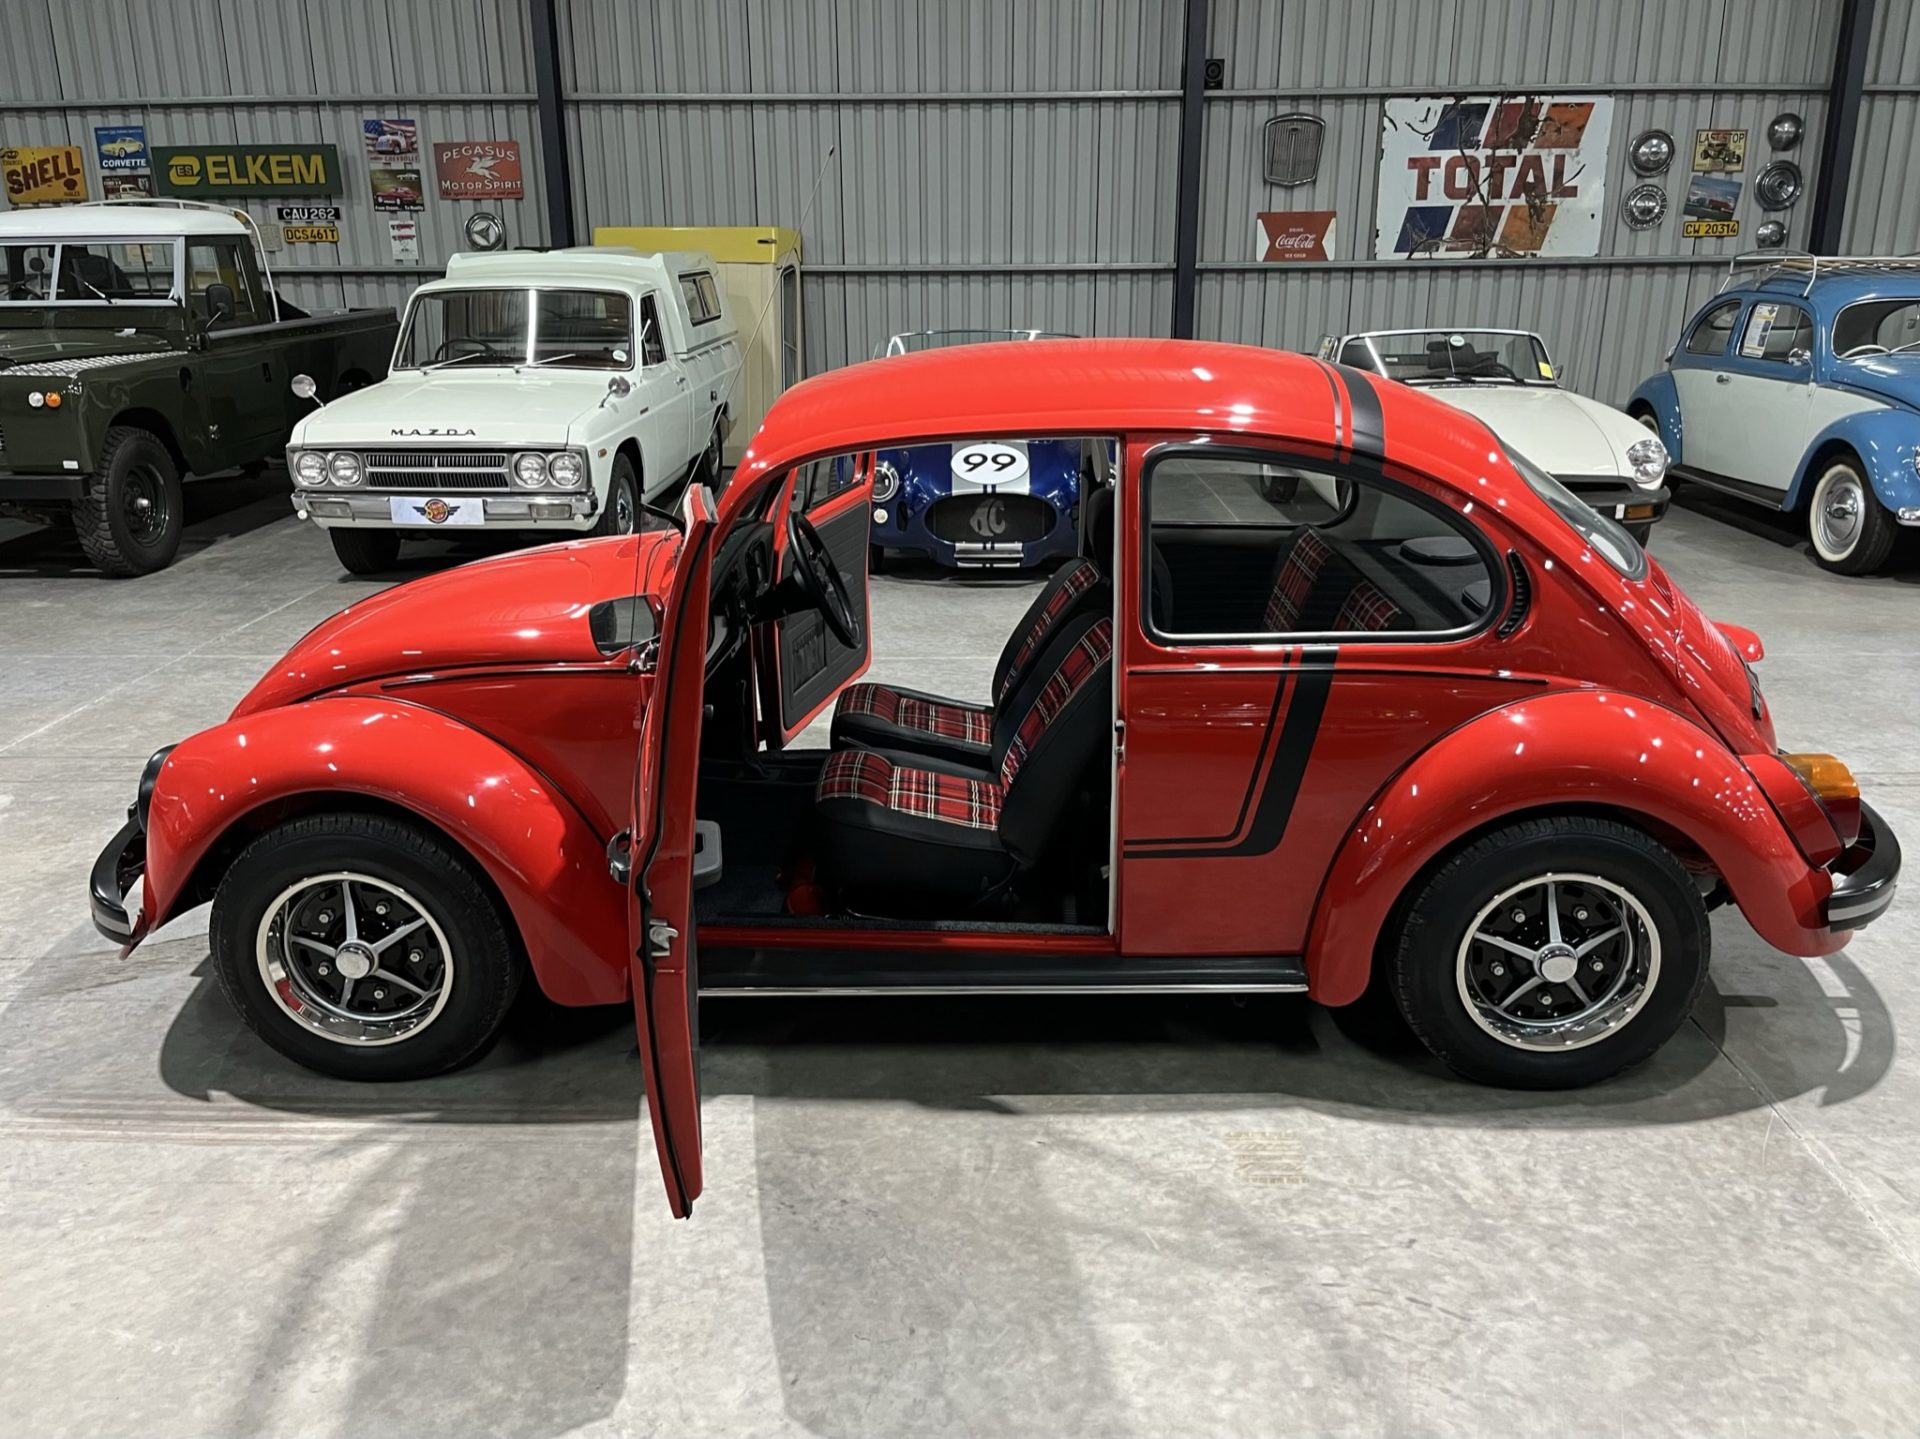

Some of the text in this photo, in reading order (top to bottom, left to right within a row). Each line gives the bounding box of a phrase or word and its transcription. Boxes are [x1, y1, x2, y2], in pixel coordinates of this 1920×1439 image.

[1699, 132, 1745, 143] LAST STOP
[442, 145, 516, 163] PEGASUS
[102, 158, 147, 168] CORVETTE
[6, 150, 81, 195] SHELL
[177, 164, 193, 176] ES
[205, 154, 326, 185] ELKEM
[1407, 153, 1578, 201] TOTAL
[441, 179, 522, 190] MOTOR SPIRIT
[282, 208, 335, 220] CAU 262
[286, 228, 336, 240] DCS461T
[1685, 222, 1738, 234] CW 20314
[1275, 233, 1316, 249] Coca-Cola
[391, 428, 476, 436] MAZDA
[963, 453, 1017, 473] 99
